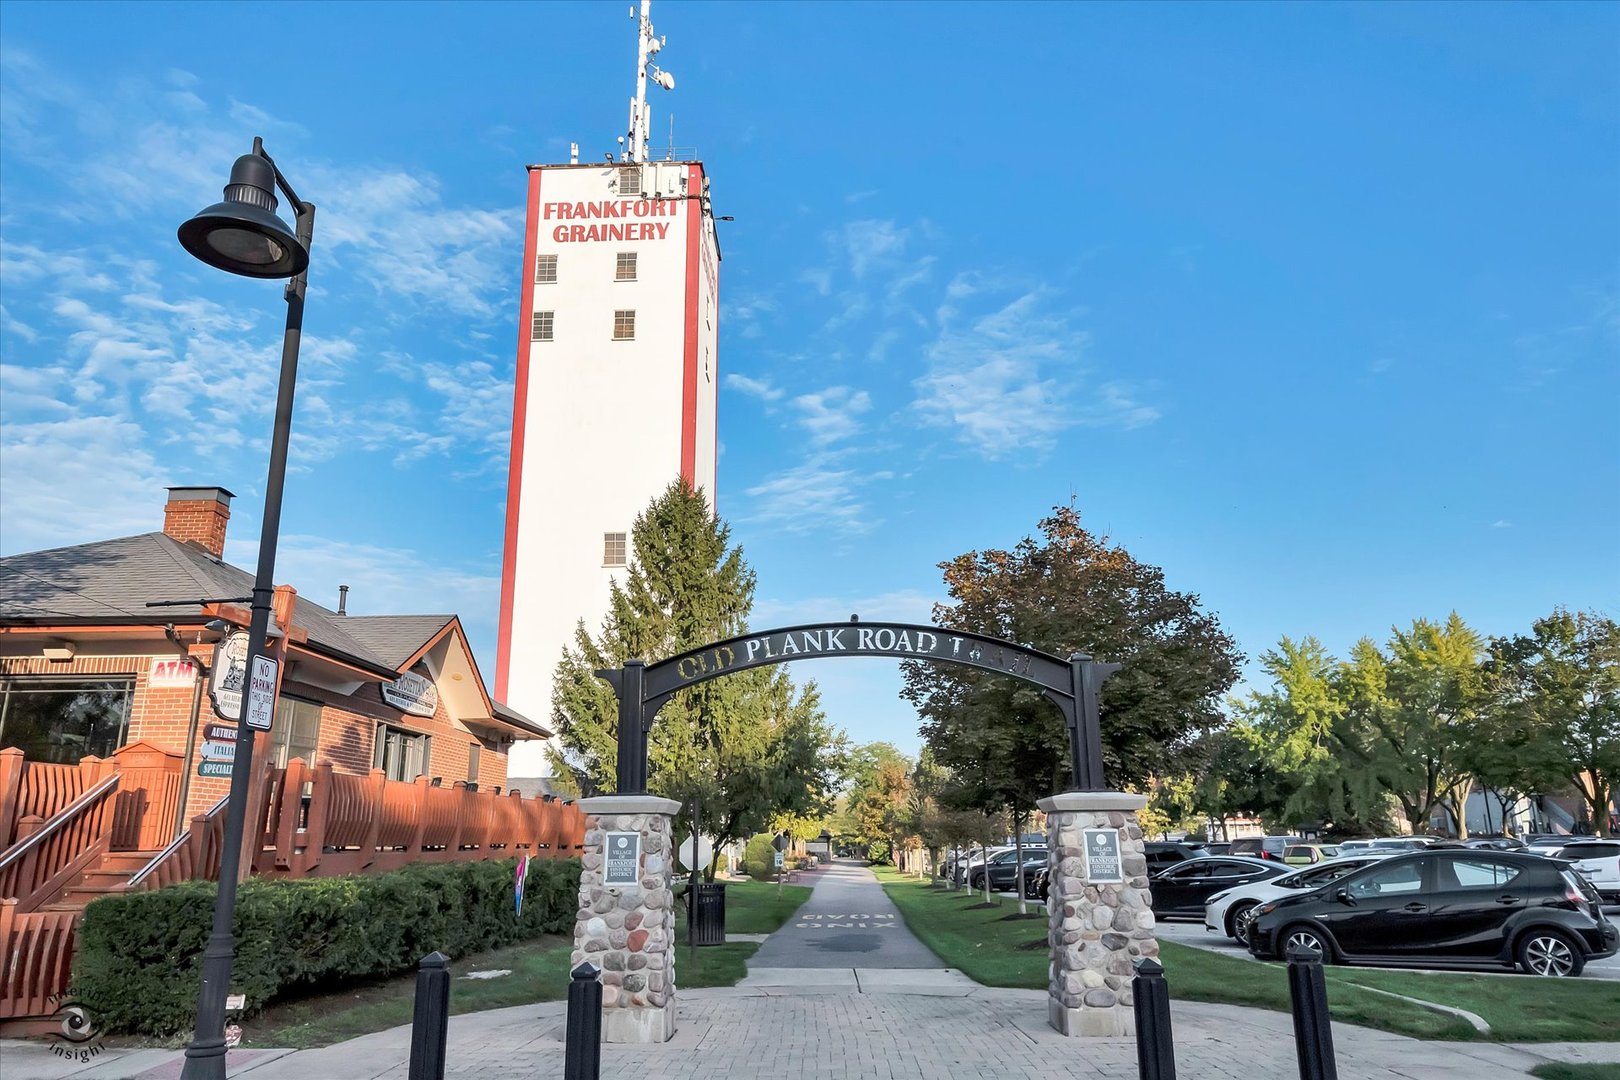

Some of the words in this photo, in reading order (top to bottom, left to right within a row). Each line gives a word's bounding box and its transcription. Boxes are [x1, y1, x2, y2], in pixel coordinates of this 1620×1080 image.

[543, 199, 678, 220] FRANKFORT
[552, 222, 670, 243] GRAINERY
[677, 646, 736, 680] OLD
[744, 628, 847, 664] PLANK
[857, 628, 937, 653] ROAD
[948, 637, 1036, 678] TIL
[154, 661, 193, 679] ATM
[259, 662, 270, 678] NO
[252, 677, 274, 694] PARKING
[252, 691, 261, 701] THIS
[262, 694, 272, 705] SIDE
[252, 709, 268, 721] STREET
